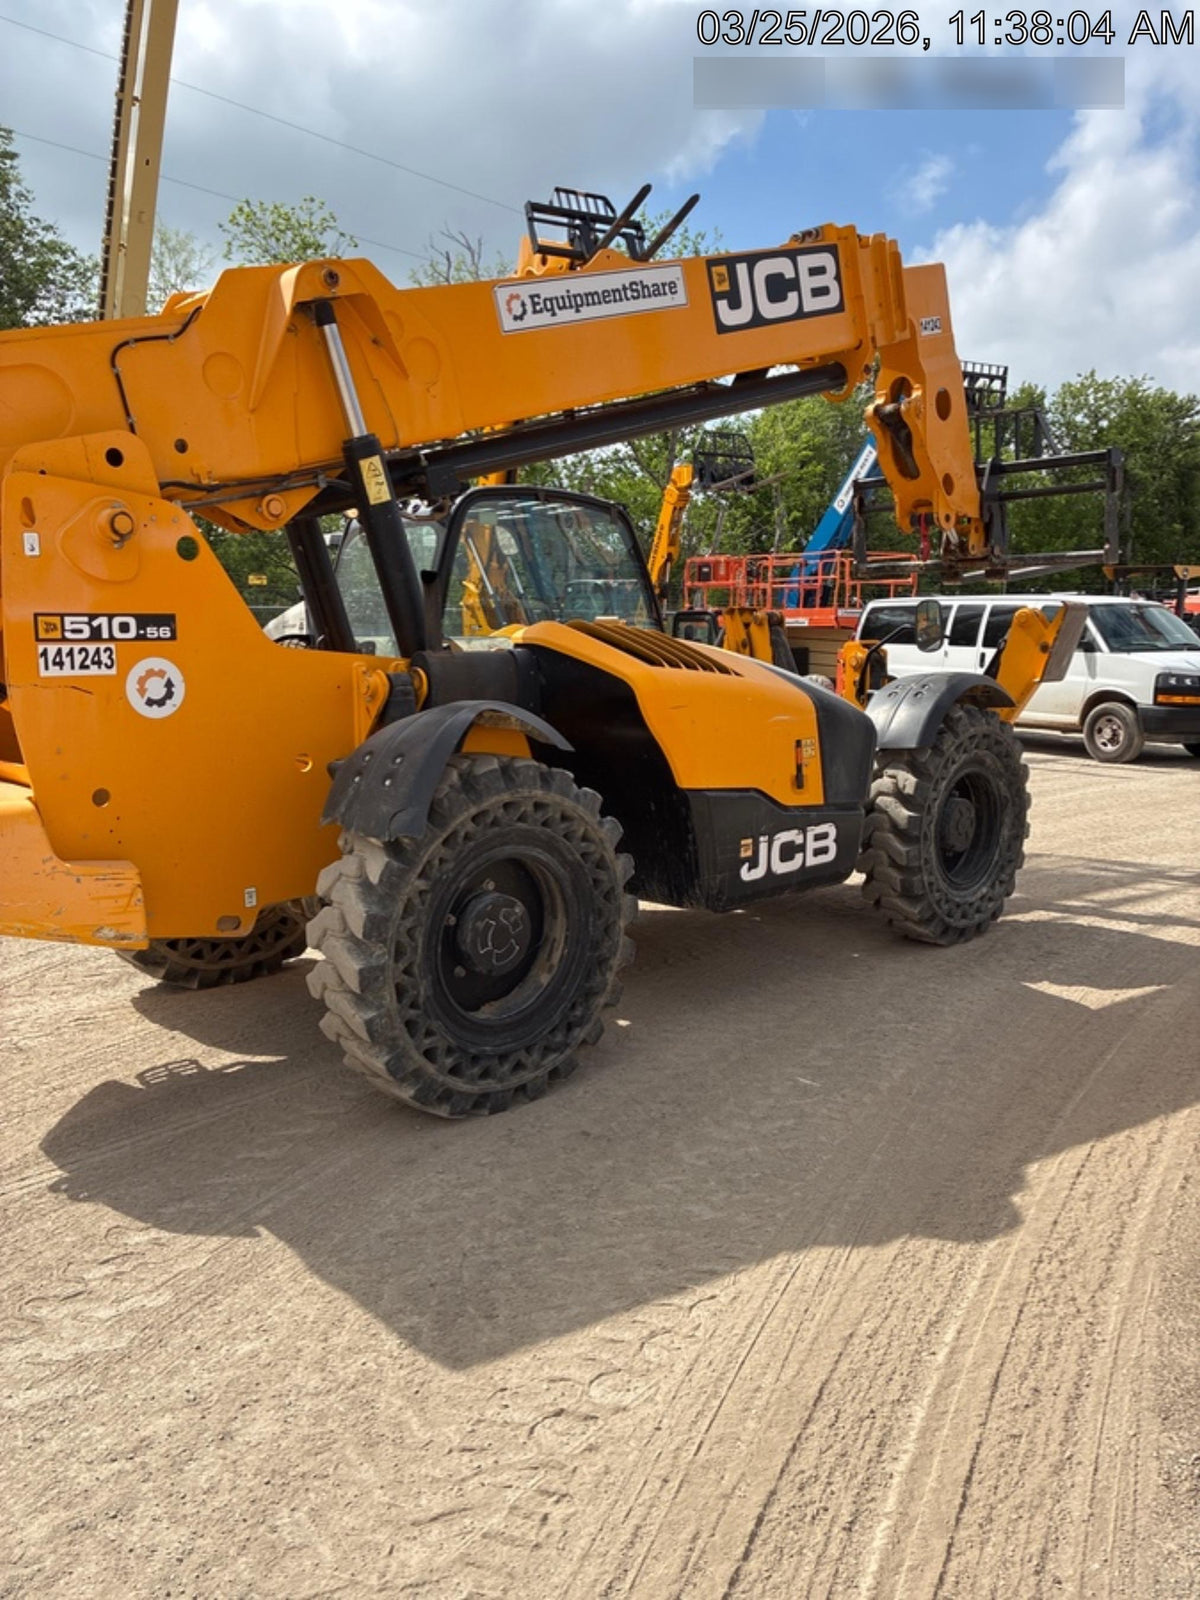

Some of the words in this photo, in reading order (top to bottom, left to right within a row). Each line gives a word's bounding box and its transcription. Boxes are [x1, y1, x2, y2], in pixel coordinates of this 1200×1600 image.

[528, 280, 679, 317] EquipmentShare
[716, 252, 841, 326] JCB
[63, 616, 172, 640] 510-56
[39, 646, 115, 671] 141243
[740, 822, 837, 882] JCB
